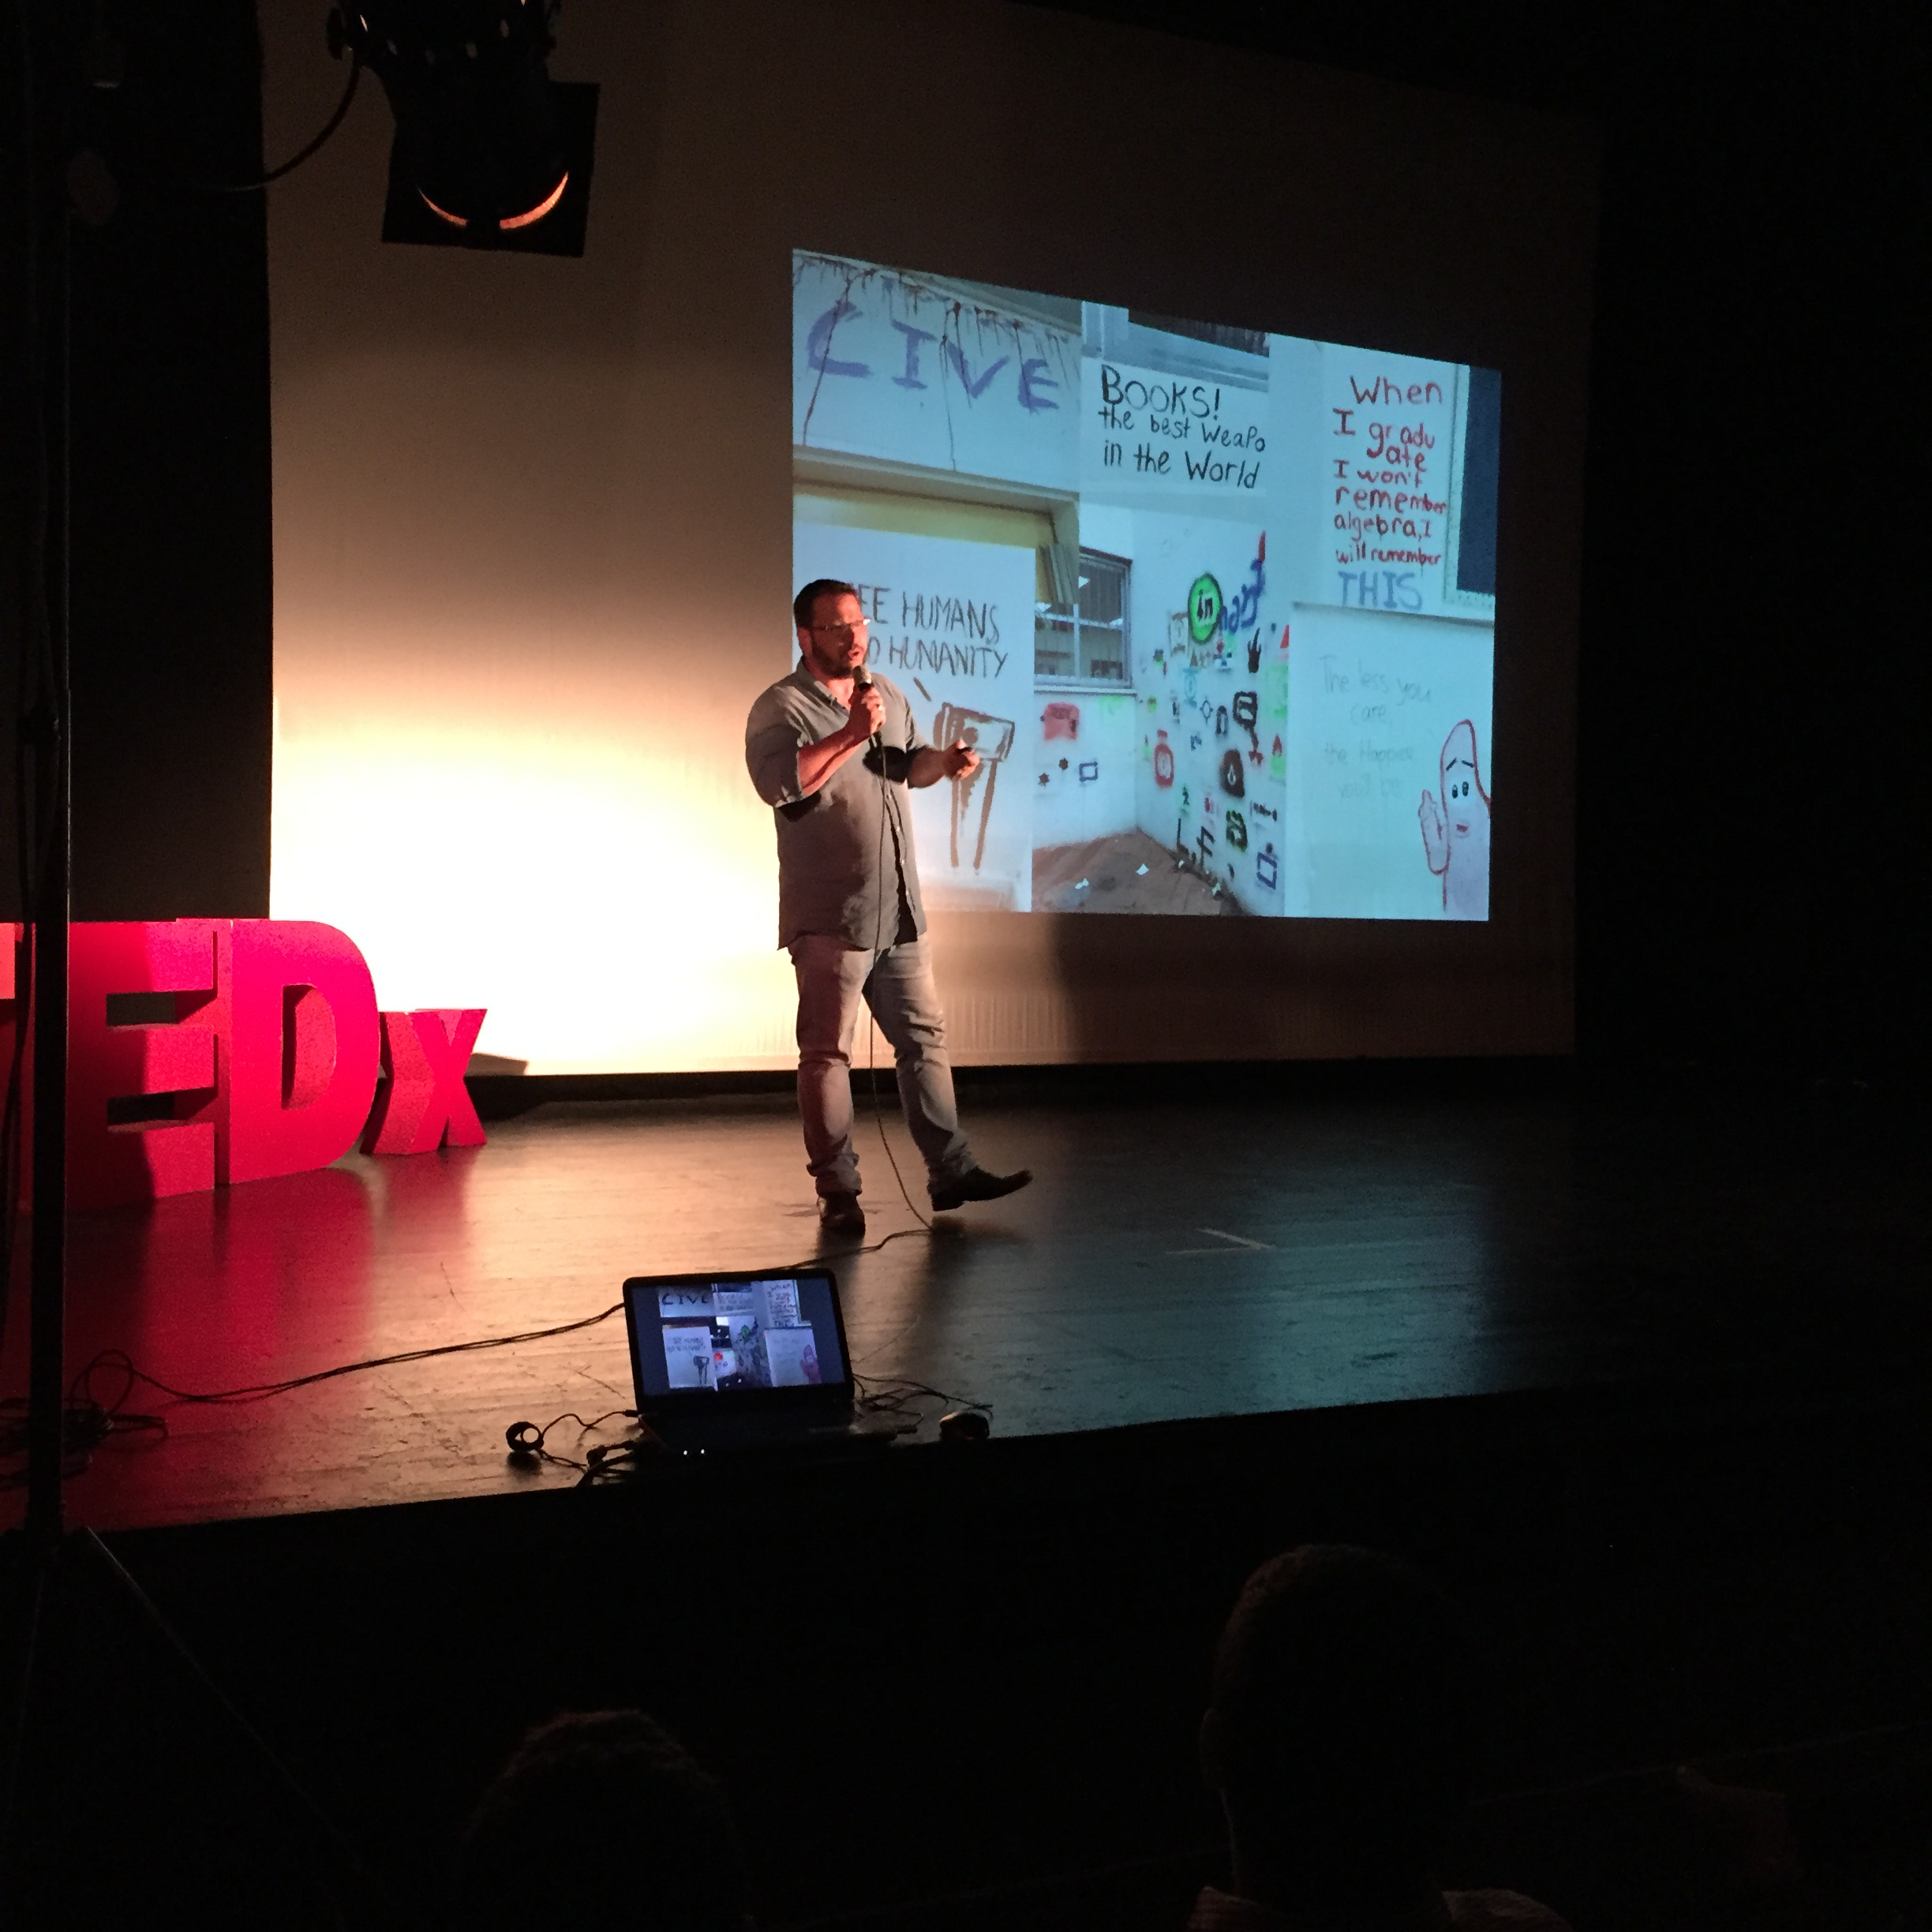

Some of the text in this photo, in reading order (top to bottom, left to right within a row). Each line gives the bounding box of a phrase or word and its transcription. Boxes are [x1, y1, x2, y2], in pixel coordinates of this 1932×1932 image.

[1350, 375, 1442, 405] When
[1098, 404, 1134, 429] the
[1151, 414, 1190, 439] best
[1333, 408, 1436, 459] I gradu
[1103, 440, 1122, 467] in
[1133, 443, 1171, 474] the
[1333, 459, 1350, 478] I
[1386, 444, 1426, 472] ate
[1335, 485, 1447, 514] remember
[1335, 541, 1366, 564] will
[1338, 571, 1423, 610] THIS
[857, 583, 1000, 645] EE HUMANS
[1318, 653, 1432, 706] The less you
[0, 919, 488, 1215] EDx
